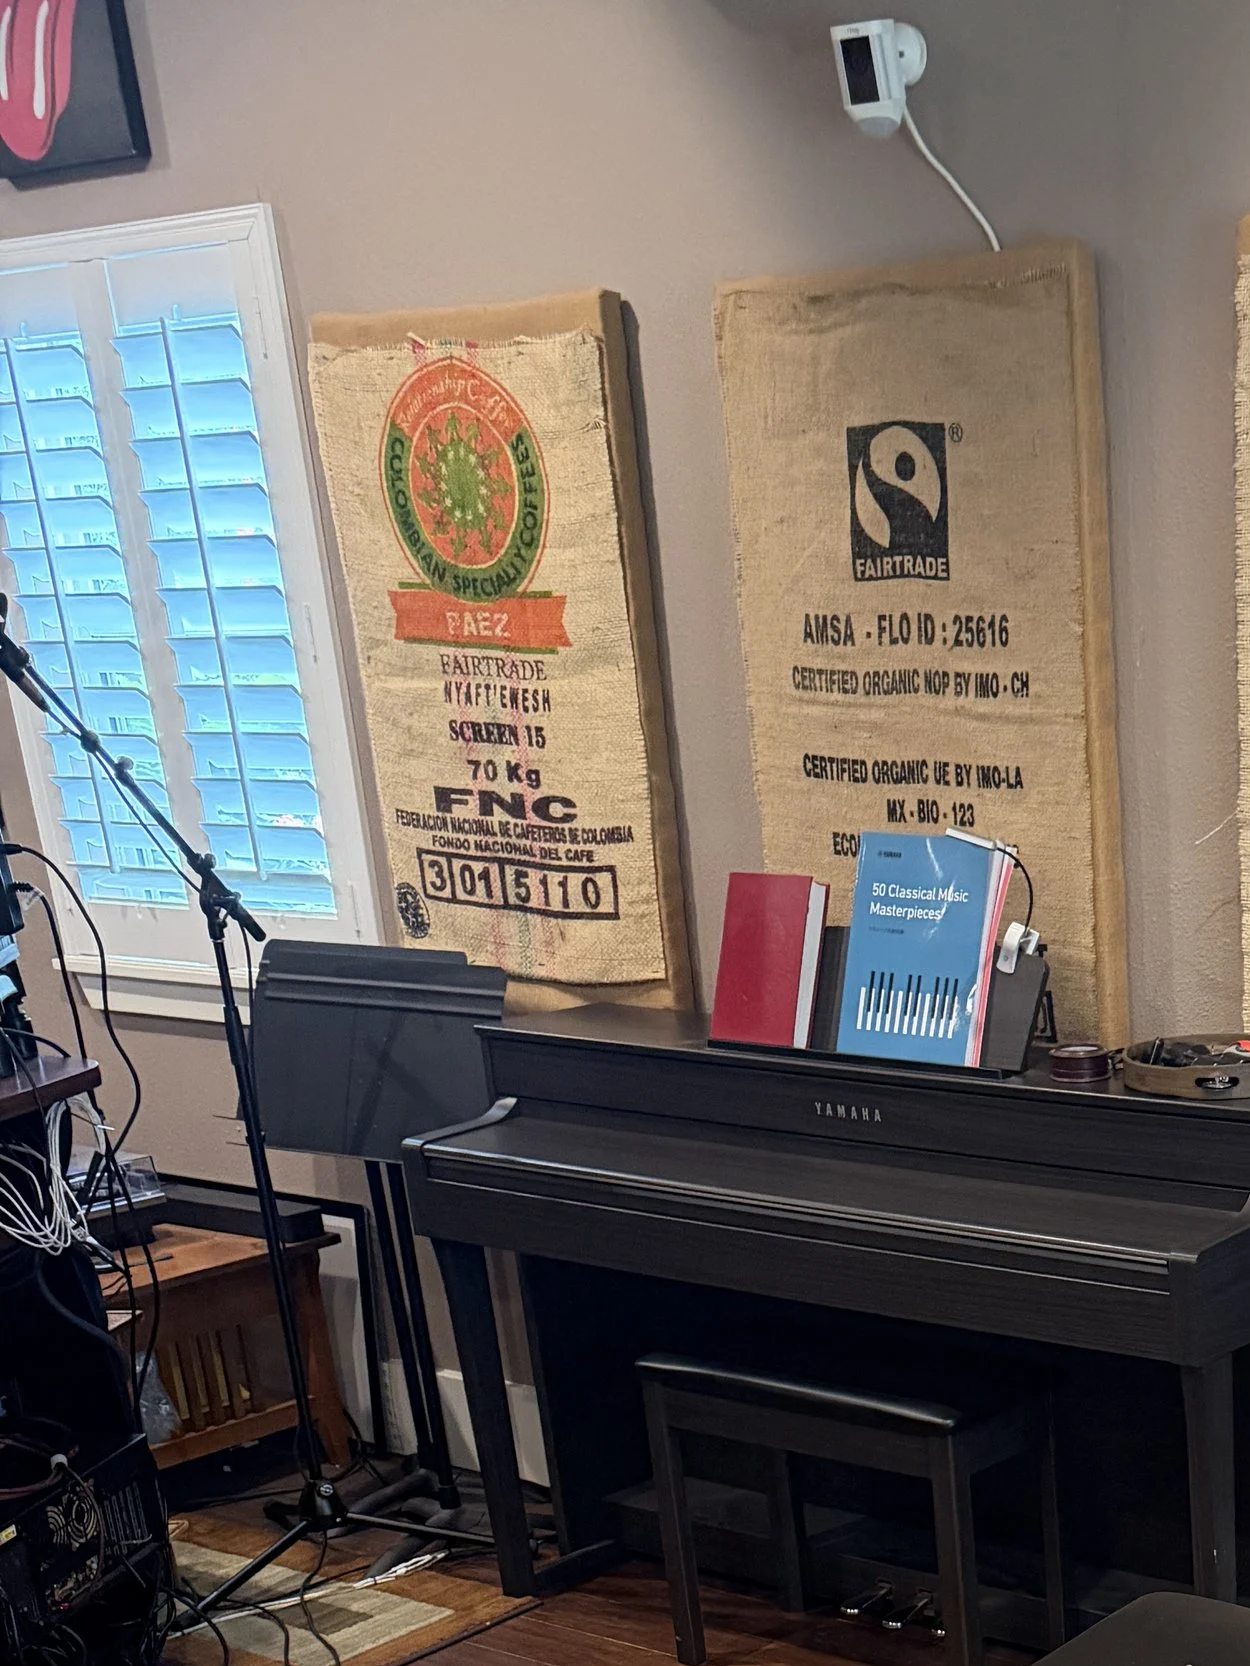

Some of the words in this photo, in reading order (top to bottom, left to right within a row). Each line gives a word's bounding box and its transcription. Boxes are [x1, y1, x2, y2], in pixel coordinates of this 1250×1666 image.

[389, 437, 447, 583] COLOMBIAN
[511, 432, 540, 549] COFFEES
[855, 555, 948, 579] FAIRTRADE
[446, 610, 512, 637] PAEZ
[803, 613, 856, 647] AMSA
[877, 612, 911, 646] FLO
[917, 612, 936, 646] ID
[952, 614, 1009, 648] 25616
[440, 654, 547, 681] FAIRTRADE
[792, 665, 859, 696] CERTIFIED
[863, 668, 920, 697] ORGANIC
[924, 668, 950, 696] NOP
[954, 671, 971, 698] BY
[1011, 671, 1029, 698] CH
[449, 720, 519, 746] SCREEN
[525, 725, 546, 749] 15
[467, 759, 498, 782] 70
[506, 760, 541, 790] Kg
[803, 753, 868, 784] CERTIFIED
[872, 759, 929, 785] ORGANIC
[934, 761, 950, 786] UE
[955, 763, 971, 788] BY
[976, 765, 1024, 790] IMO-LA
[433, 785, 578, 824] FNC
[887, 799, 907, 824] MX
[917, 799, 939, 824] BIO
[952, 801, 975, 828] 123
[395, 808, 449, 833] FEDERACION
[451, 816, 498, 838] NACIONAL
[500, 820, 511, 839] DE
[514, 823, 567, 844] CAFETEROS
[581, 825, 634, 845] COLOMBIA
[432, 834, 470, 851] FONDO
[474, 839, 535, 858] NACIONAL
[539, 846, 562, 861] DEL
[565, 849, 594, 863] CAFE
[832, 832, 860, 857] ECO
[427, 860, 447, 892] 3
[459, 863, 493, 900] 01
[514, 868, 600, 910] 5110
[872, 882, 886, 897] 50
[888, 884, 936, 901] Classical
[937, 888, 969, 903] Music
[869, 902, 941, 921] Masterpieces
[815, 1101, 882, 1122] YAMAHA
